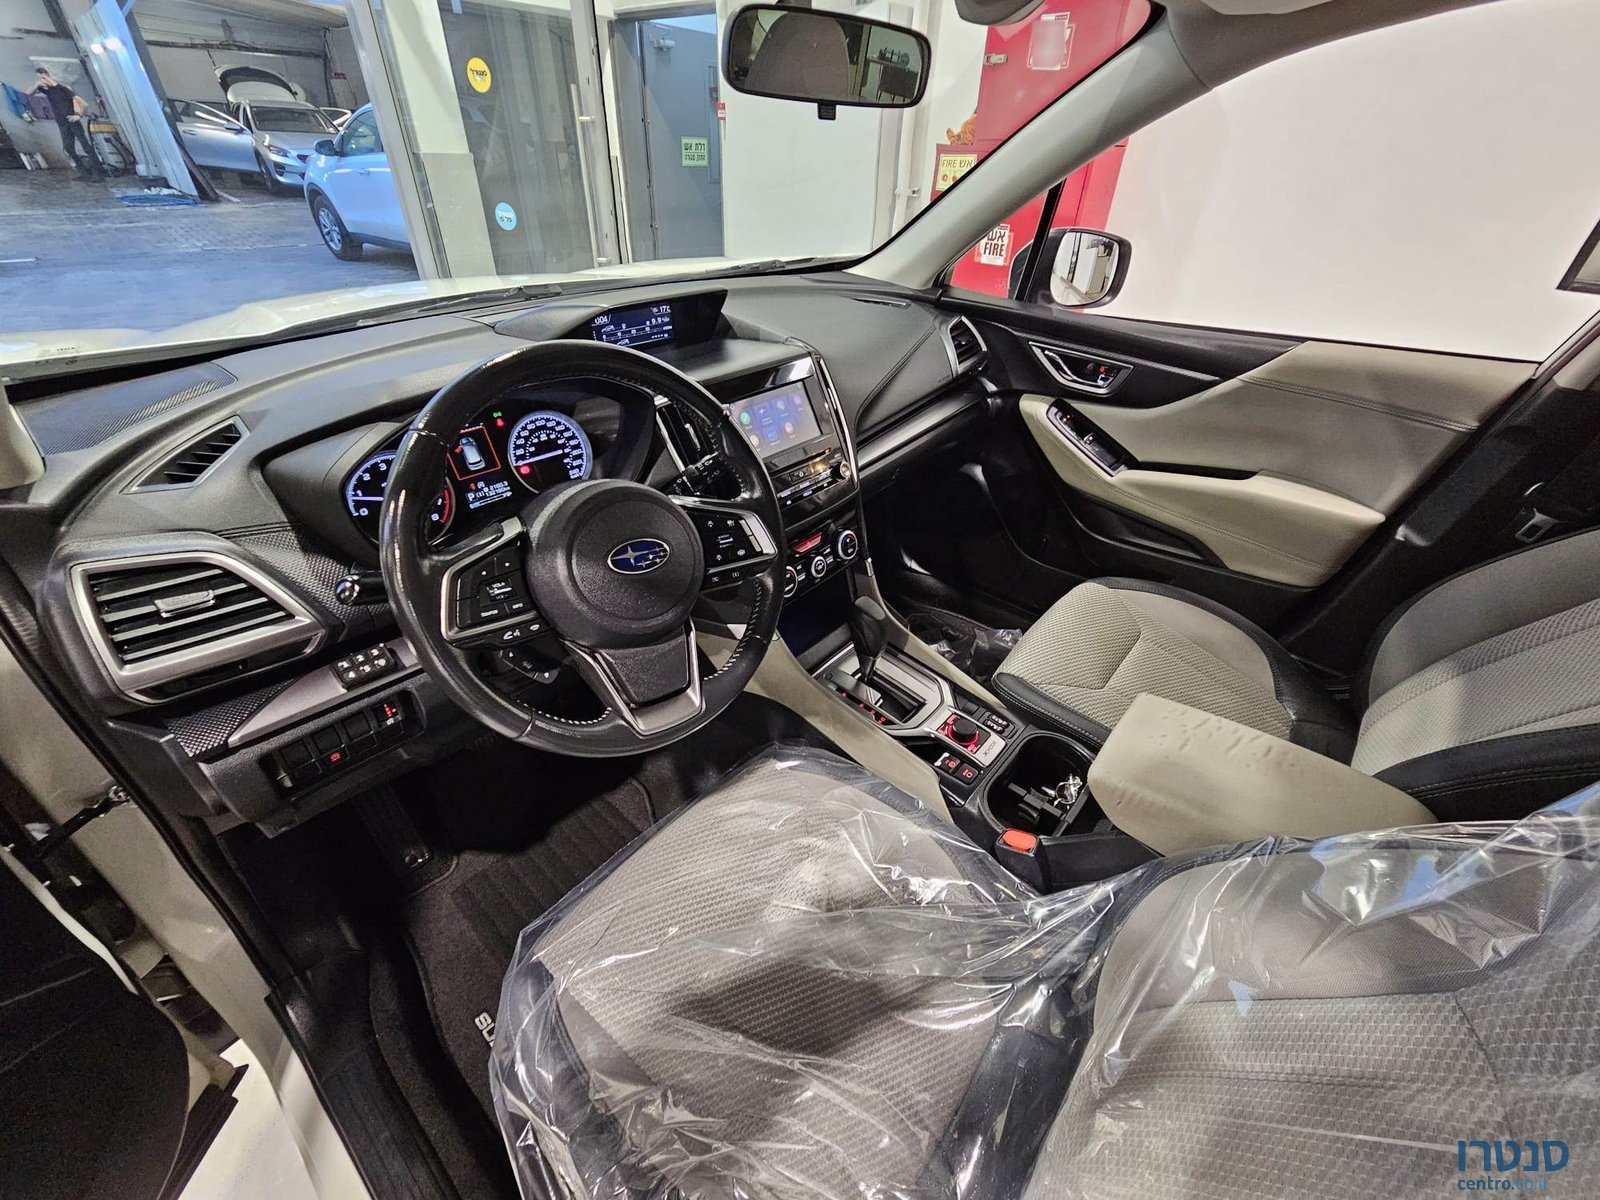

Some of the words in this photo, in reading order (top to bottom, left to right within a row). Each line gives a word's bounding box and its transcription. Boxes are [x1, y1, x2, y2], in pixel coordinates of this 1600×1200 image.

[942, 159, 957, 168] FIRE
[983, 241, 1005, 257] FIRE
[380, 462, 387, 471] 3
[362, 473, 371, 481] 2
[360, 507, 369, 516] 0
